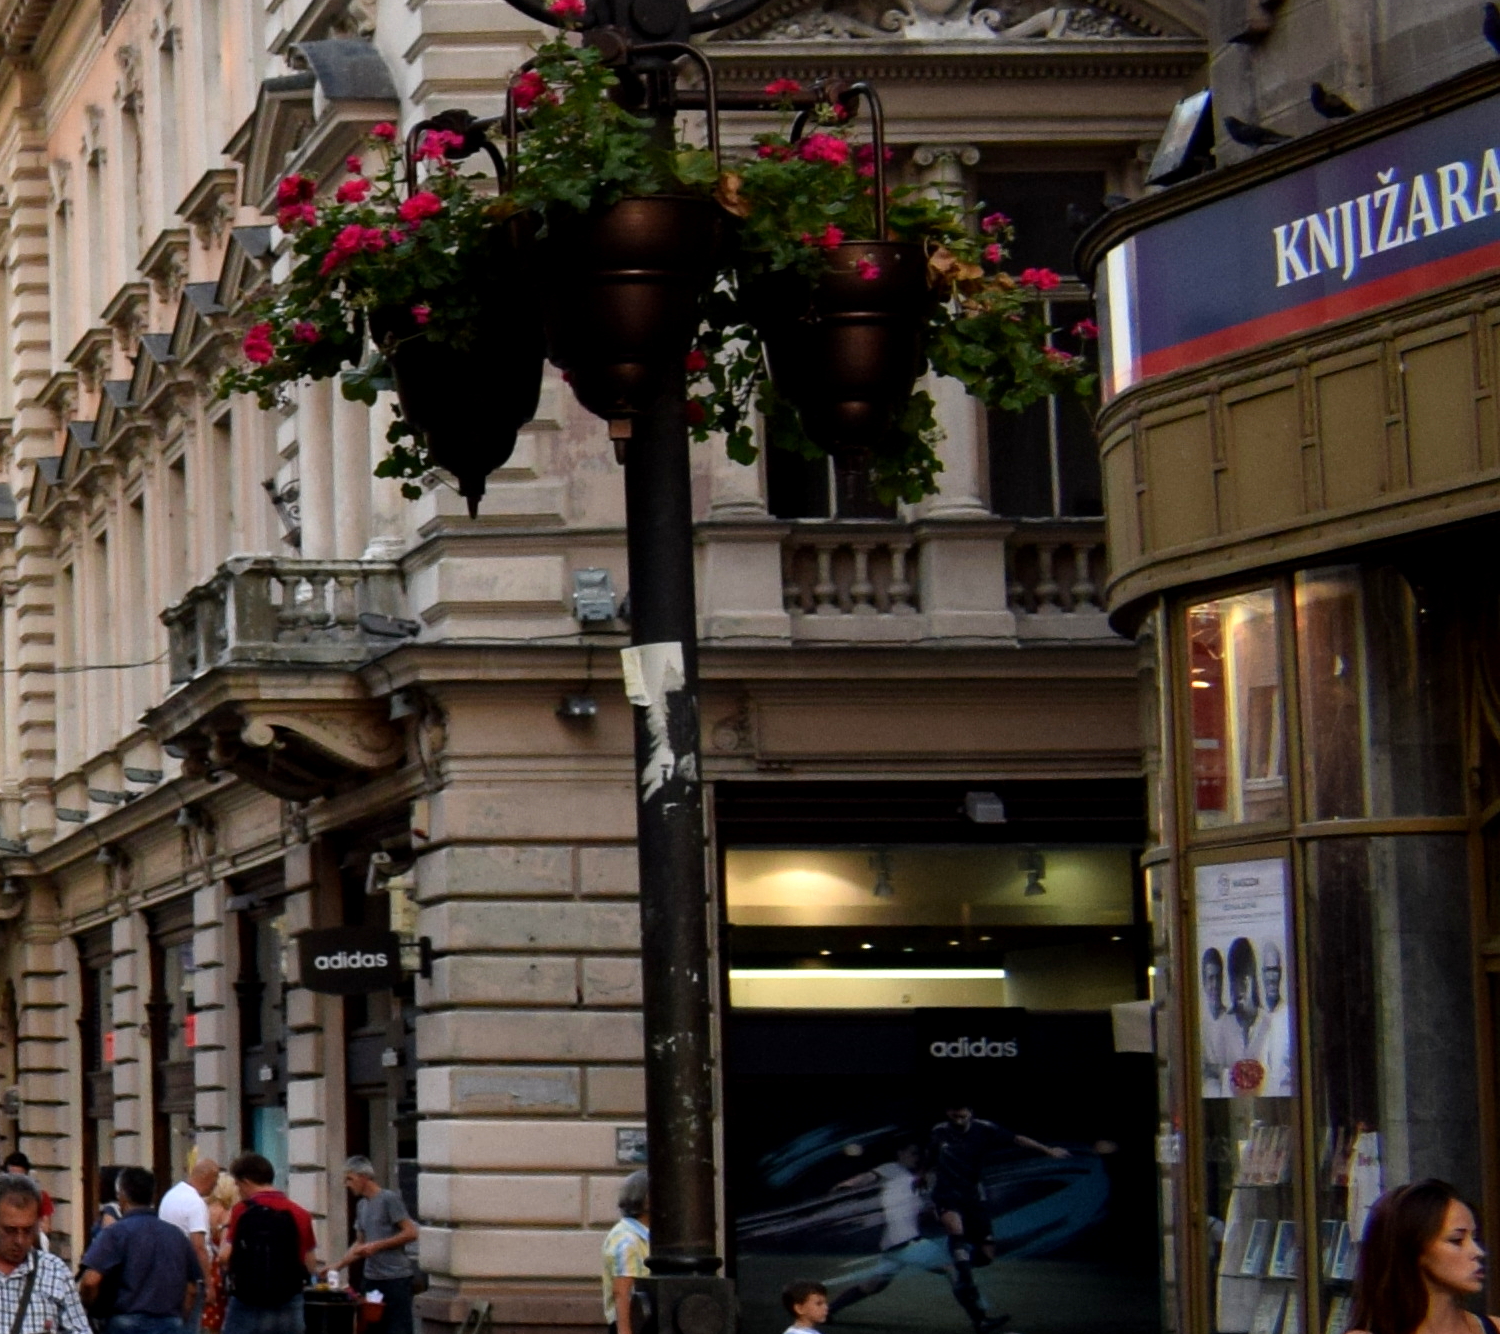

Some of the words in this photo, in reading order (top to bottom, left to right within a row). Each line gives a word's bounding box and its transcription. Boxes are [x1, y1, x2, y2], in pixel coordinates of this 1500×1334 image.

[1273, 147, 1500, 287] KNJIŽARA
[314, 950, 388, 970] adidas
[929, 1036, 1018, 1058] adidas
